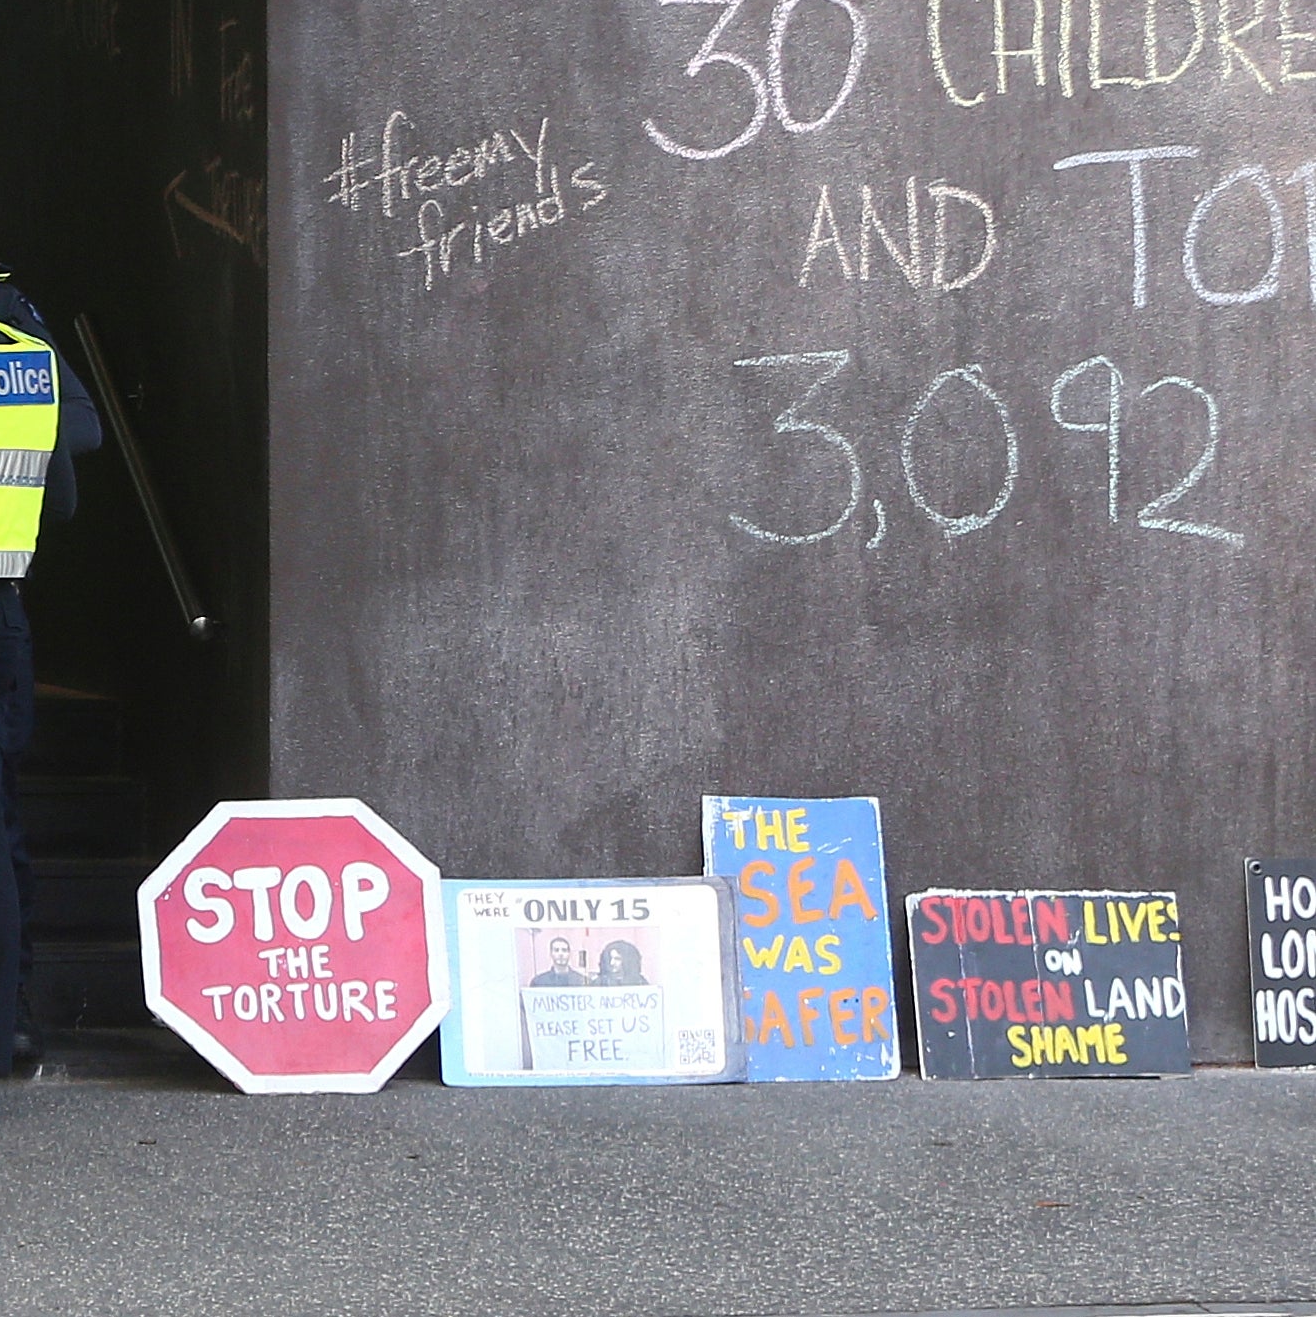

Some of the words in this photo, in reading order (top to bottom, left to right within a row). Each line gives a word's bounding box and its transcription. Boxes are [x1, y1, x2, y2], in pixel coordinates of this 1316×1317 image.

[396, 161, 608, 291] friends
[798, 175, 996, 293] AND
[728, 349, 1245, 551] 3,092
[722, 806, 810, 853] THE
[182, 860, 391, 944] STOP
[464, 891, 505, 905] THEY
[473, 906, 510, 918] WERE
[610, 898, 650, 921] 15
[741, 857, 879, 928] SEA
[920, 896, 1068, 945] STOLEN
[258, 944, 335, 981] THE
[743, 934, 841, 975] WAS
[1046, 948, 1083, 976] ON
[202, 981, 398, 1024] TORTURE
[532, 994, 596, 1013] MINSTER
[599, 992, 658, 1010] ANDREWS
[931, 978, 1074, 1024] STOLEN
[1084, 976, 1185, 1021] LAND
[535, 1019, 579, 1037] PLEASE
[587, 1018, 614, 1035] SET
[621, 1015, 651, 1033] US
[1006, 1021, 1128, 1069] SHAME
